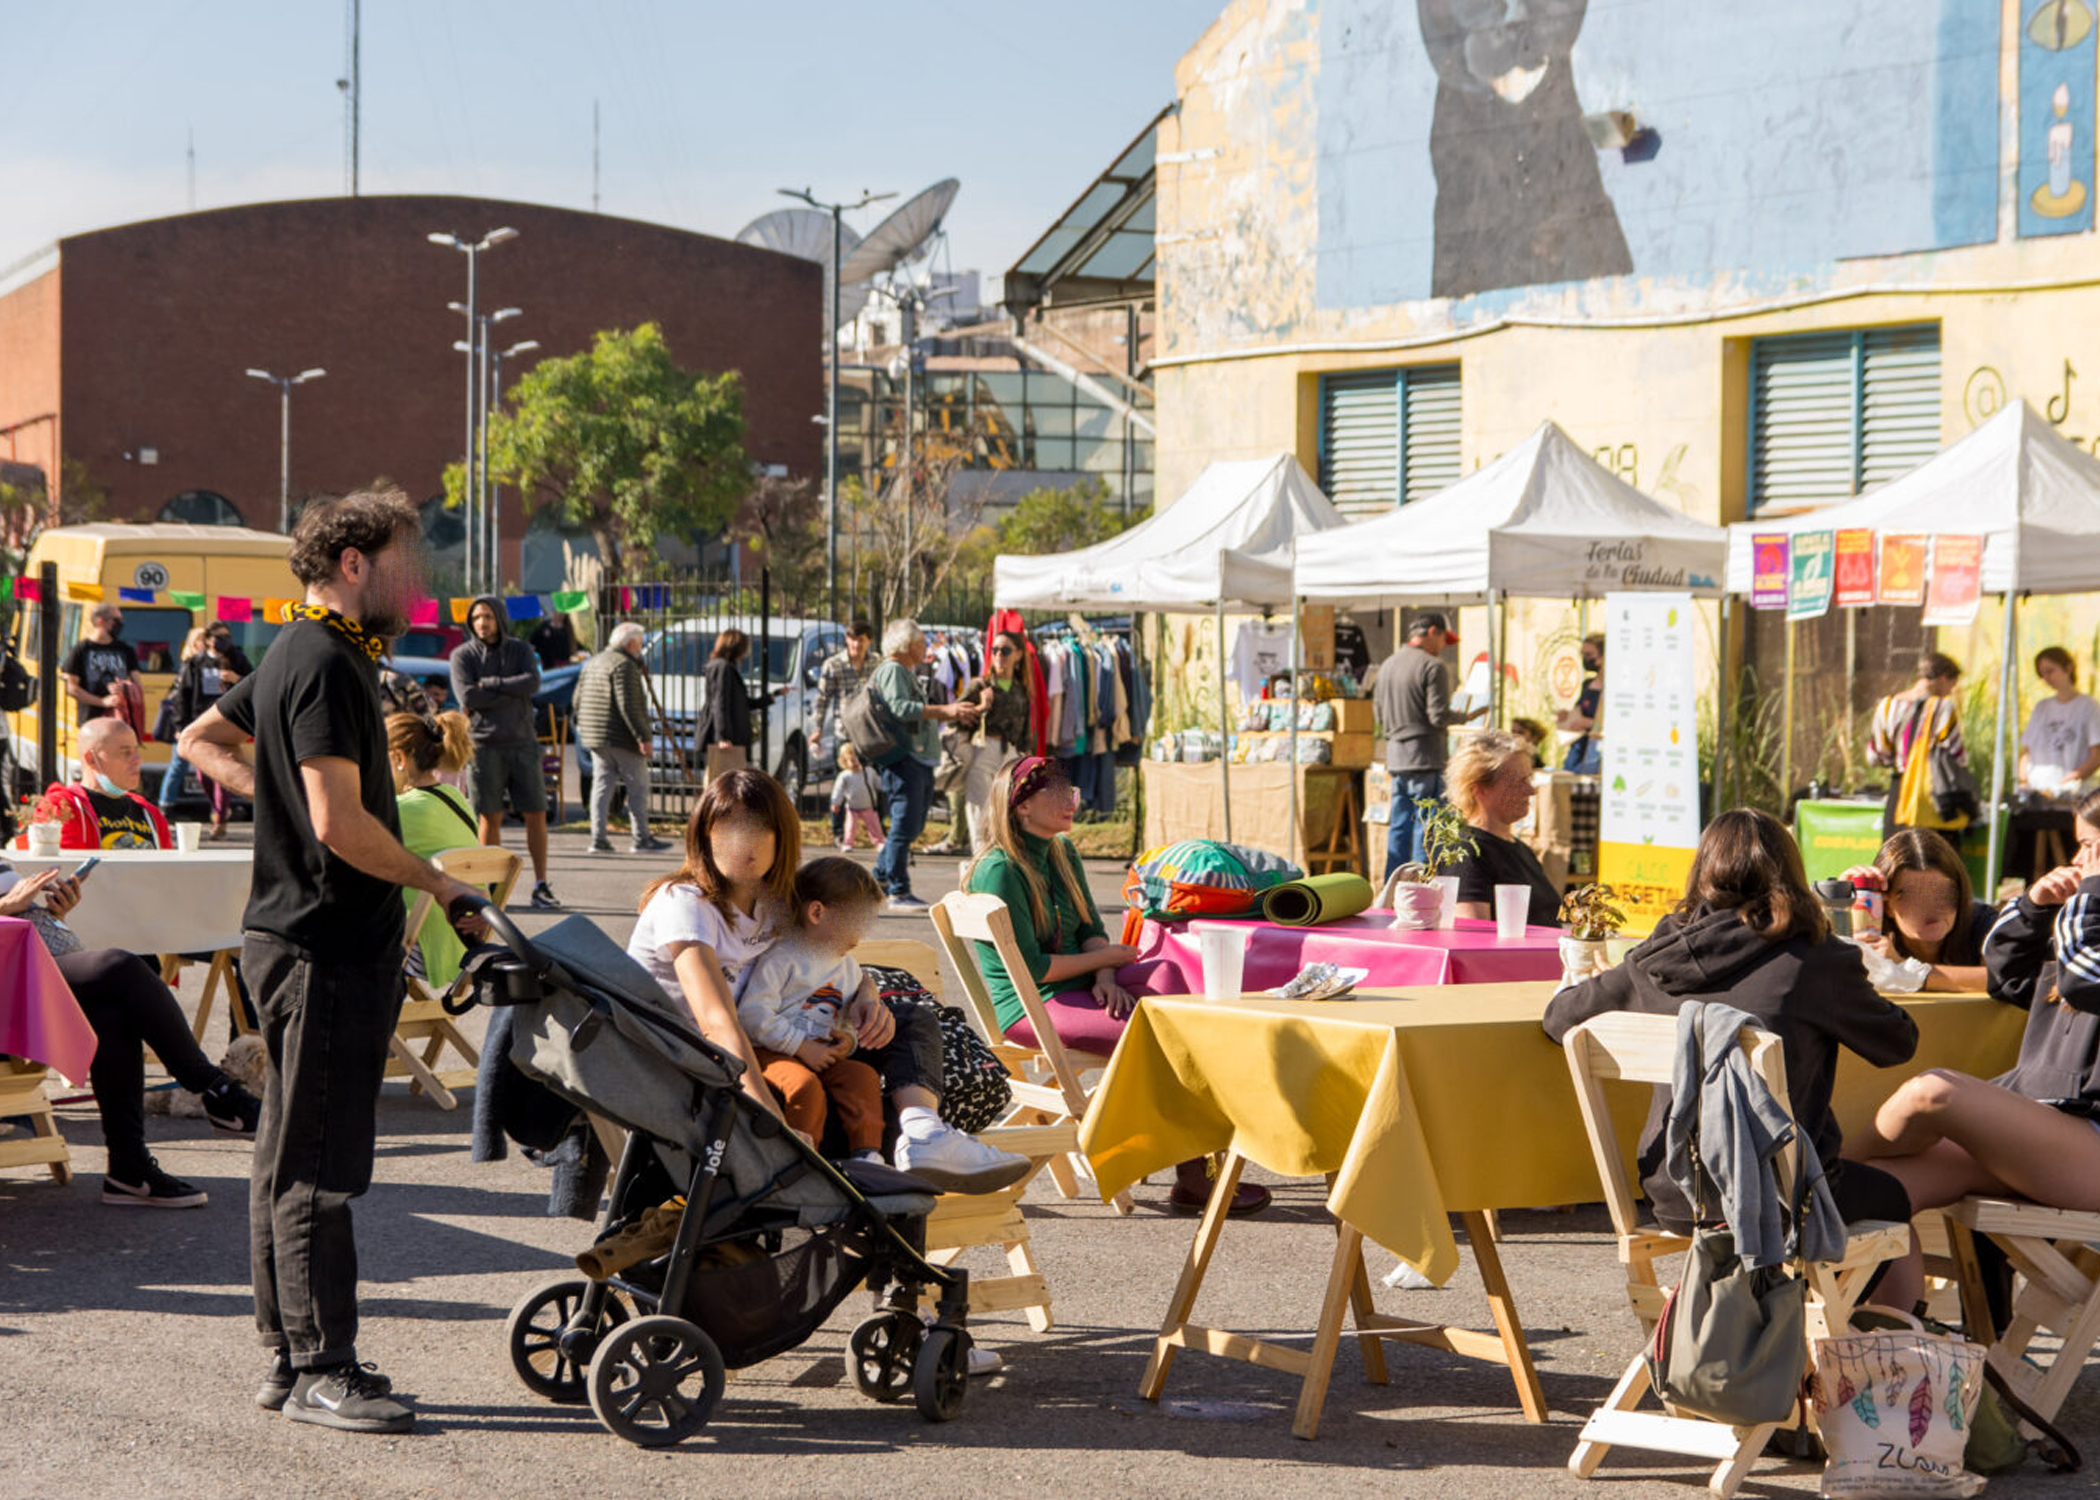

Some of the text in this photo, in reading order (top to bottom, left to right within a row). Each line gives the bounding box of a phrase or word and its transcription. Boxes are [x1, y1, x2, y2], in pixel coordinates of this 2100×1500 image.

[140, 570, 164, 586] 90
[1621, 564, 1685, 587] Ciudad
[704, 1138, 727, 1177] Joie
